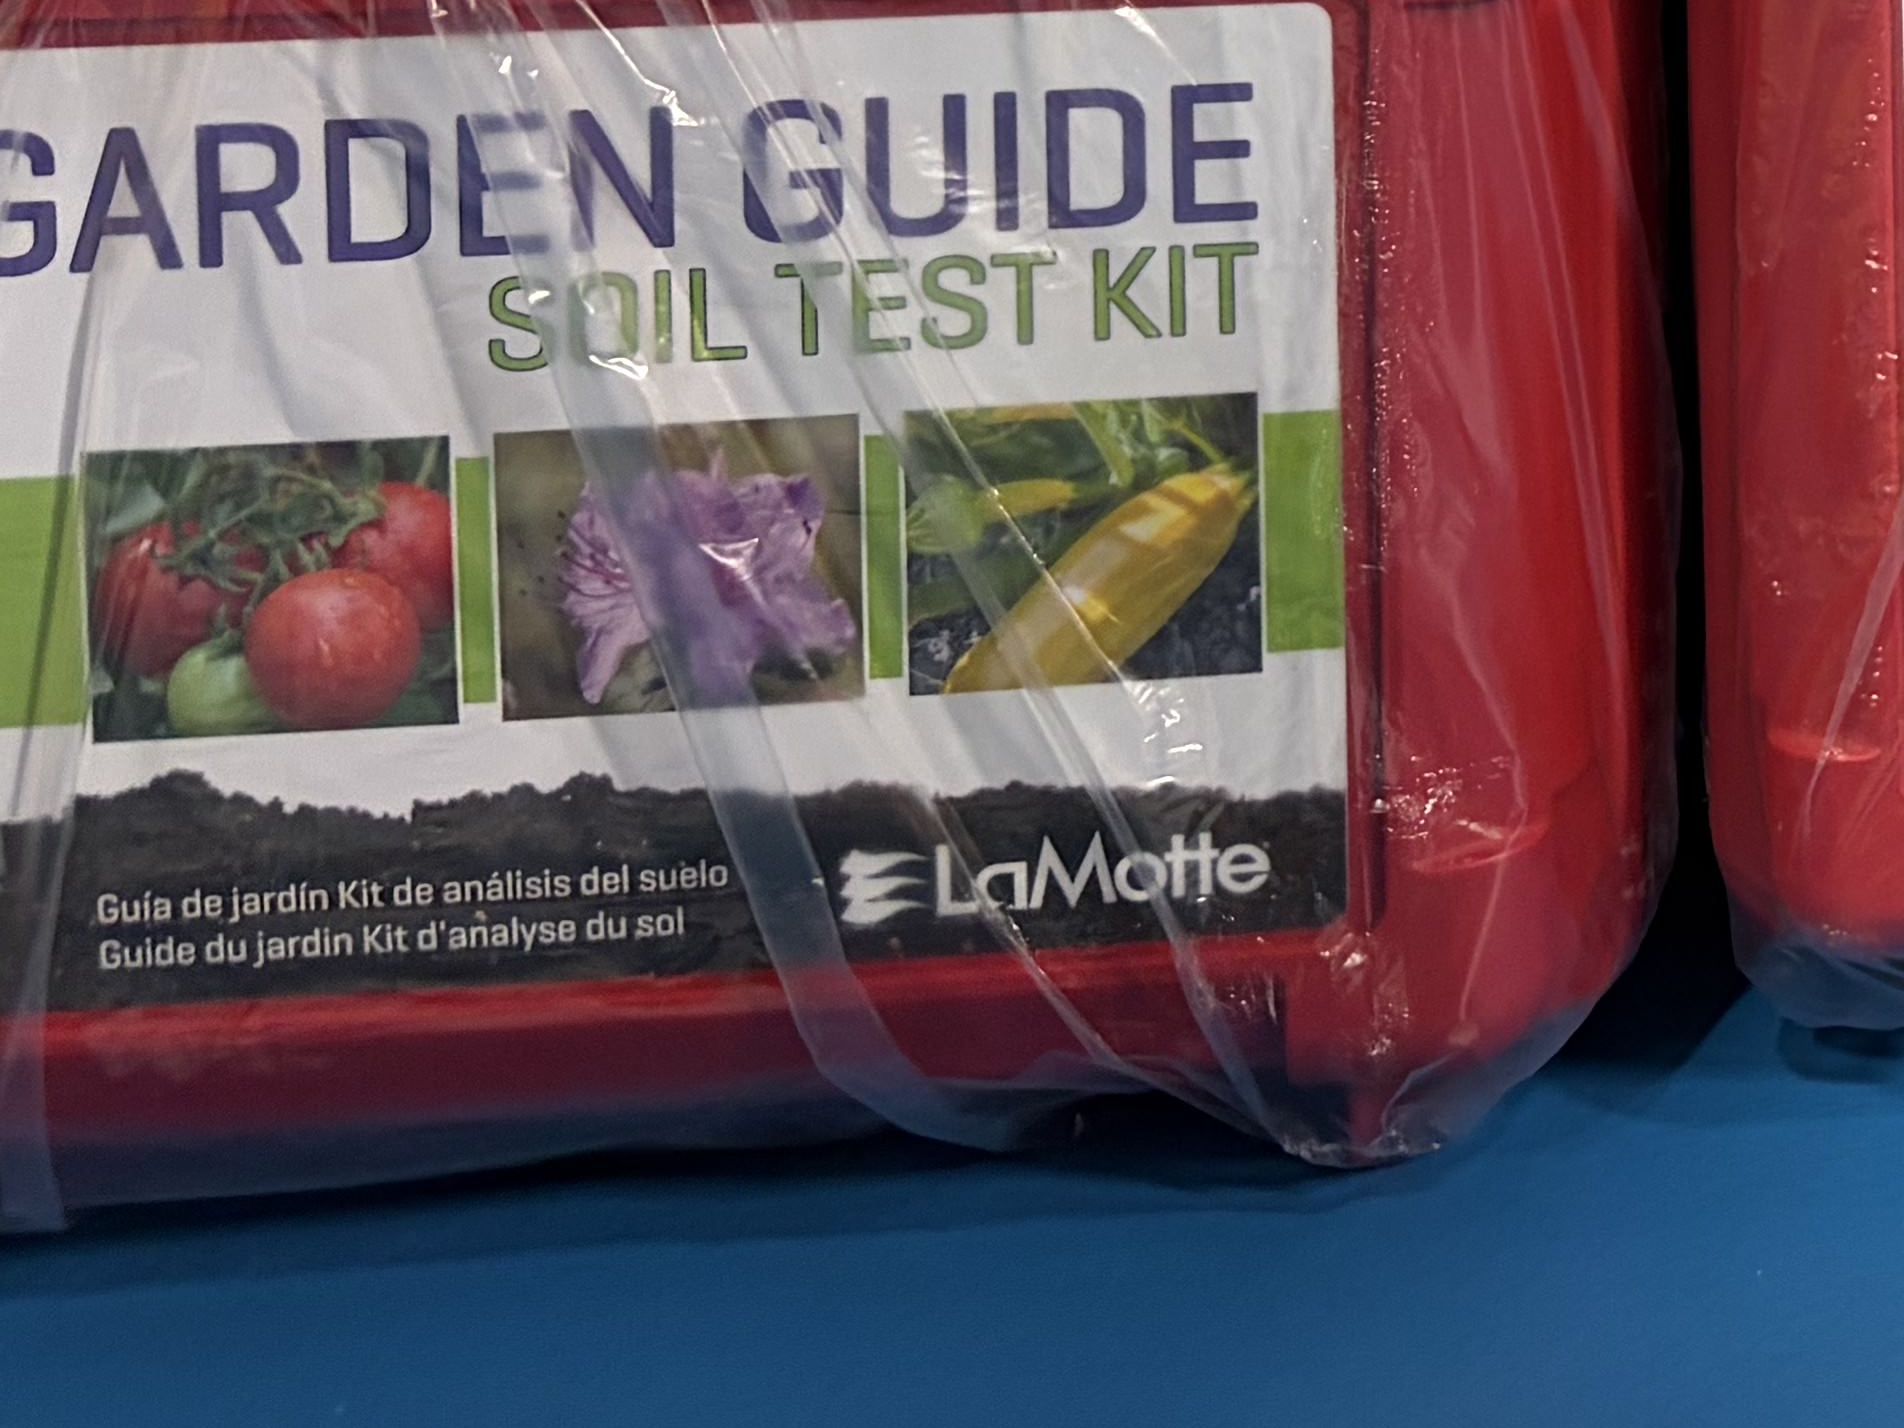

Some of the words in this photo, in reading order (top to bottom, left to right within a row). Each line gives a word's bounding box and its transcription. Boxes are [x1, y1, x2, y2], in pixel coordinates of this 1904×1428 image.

[0, 106, 676, 278] GARDEN
[742, 82, 1259, 242] GUIDE
[487, 271, 748, 373] SOIL
[775, 254, 1058, 359] TEST
[1093, 244, 1260, 341] KIT
[96, 889, 171, 926] Guía
[181, 887, 223, 920] de
[230, 880, 329, 924] jardín
[338, 877, 385, 911] Kit
[393, 873, 434, 906] de
[442, 866, 571, 903] análisis
[580, 863, 629, 897] del
[639, 858, 728, 893] suelo
[935, 830, 1270, 917] LaMotte
[100, 931, 195, 970] Guide
[205, 929, 246, 964] du
[253, 924, 354, 969] jardin
[364, 921, 409, 955] Kit
[418, 914, 576, 954] d'analyse
[586, 909, 626, 942] du
[636, 905, 685, 939] sol
